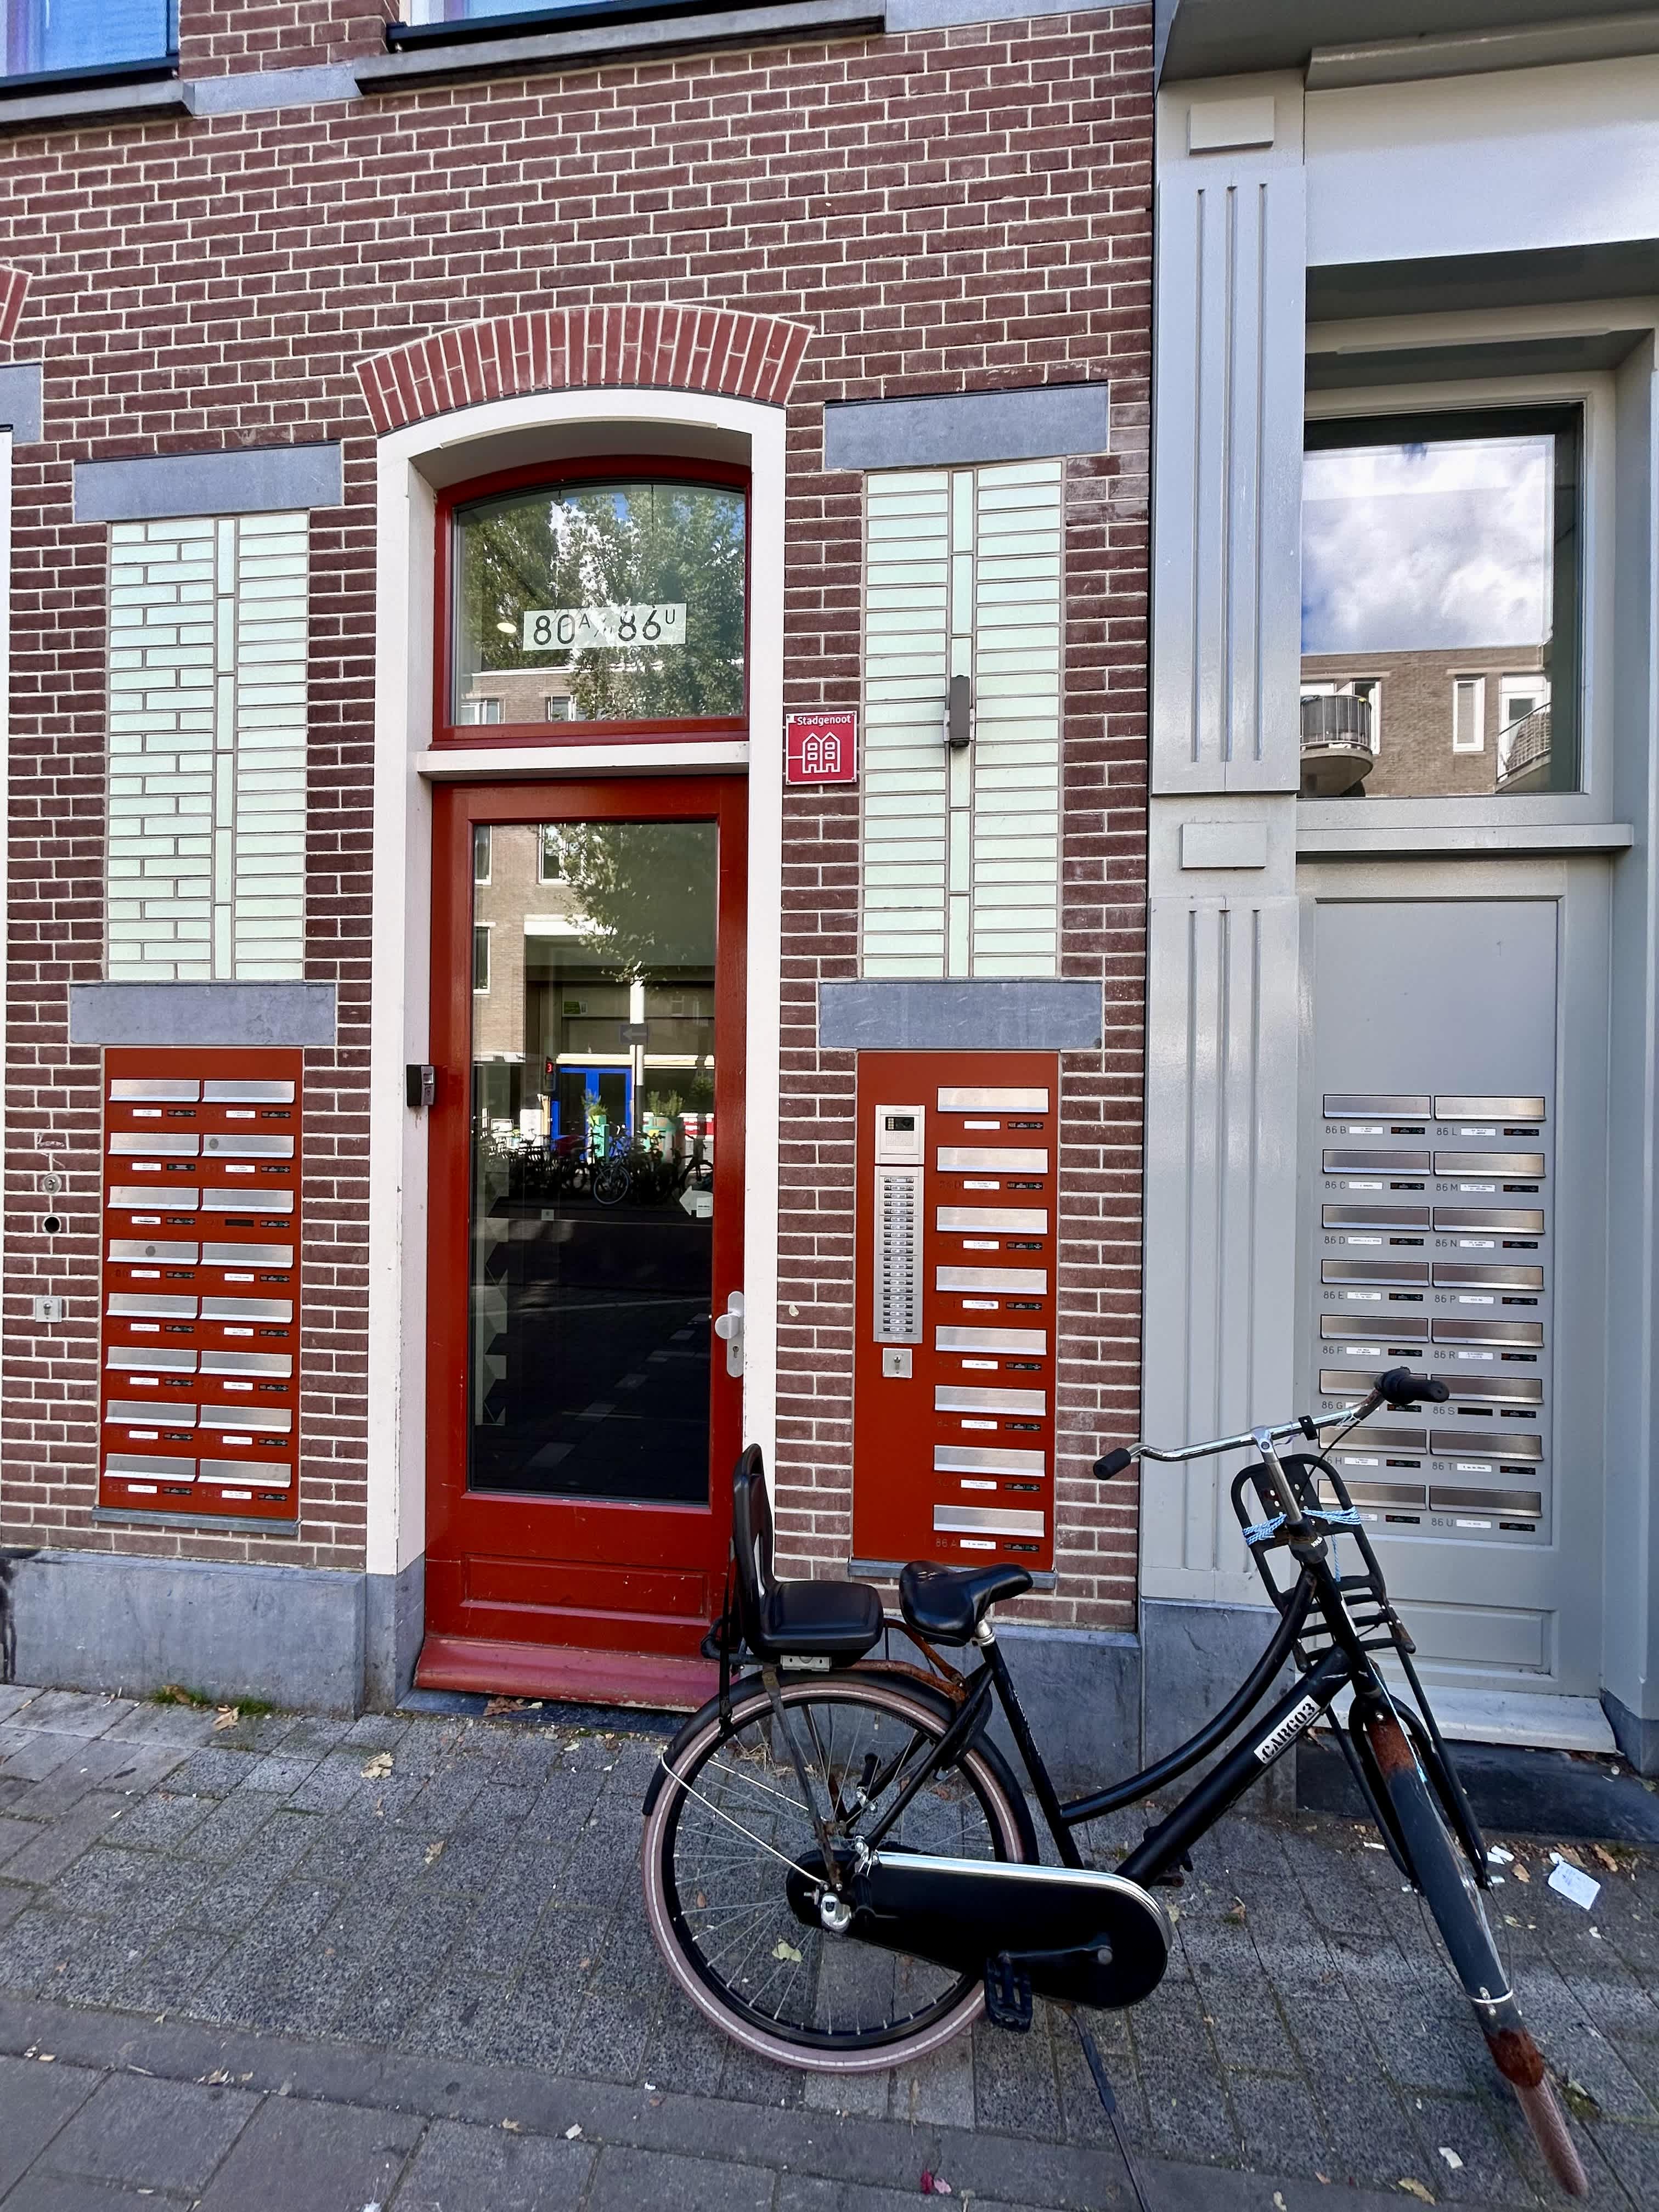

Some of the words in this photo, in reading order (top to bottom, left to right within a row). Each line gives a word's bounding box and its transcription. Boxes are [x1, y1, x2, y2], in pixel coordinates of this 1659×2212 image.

[797, 715, 851, 726] Stadgenoot
[547, 1063, 552, 1072] 3
[1325, 1125, 1338, 1135] 86
[1340, 1125, 1347, 1135] B
[1436, 1127, 1449, 1136] 86
[1452, 1127, 1458, 1136] L
[1325, 1180, 1337, 1189] 86
[1339, 1181, 1346, 1189] C
[1436, 1183, 1448, 1192] 86
[1450, 1183, 1458, 1192] M
[1324, 1235, 1336, 1244] 86
[1435, 1239, 1448, 1247] 86
[1323, 1290, 1335, 1299] 86
[1338, 1291, 1345, 1300] E
[1434, 1294, 1447, 1304] 86
[1449, 1295, 1457, 1304] P
[1322, 1345, 1335, 1355] 86
[1336, 1346, 1344, 1355] F
[1434, 1350, 1446, 1359] 86
[1448, 1350, 1455, 1359] R
[1321, 1401, 1334, 1409] 86
[1336, 1401, 1343, 1410] G
[1432, 1406, 1445, 1415] 86
[1447, 1407, 1455, 1415] S
[1335, 1457, 1342, 1465] H
[1432, 1462, 1444, 1471] 86
[1448, 1462, 1453, 1471] T
[1431, 1517, 1443, 1527] 86
[1446, 1518, 1454, 1527] U
